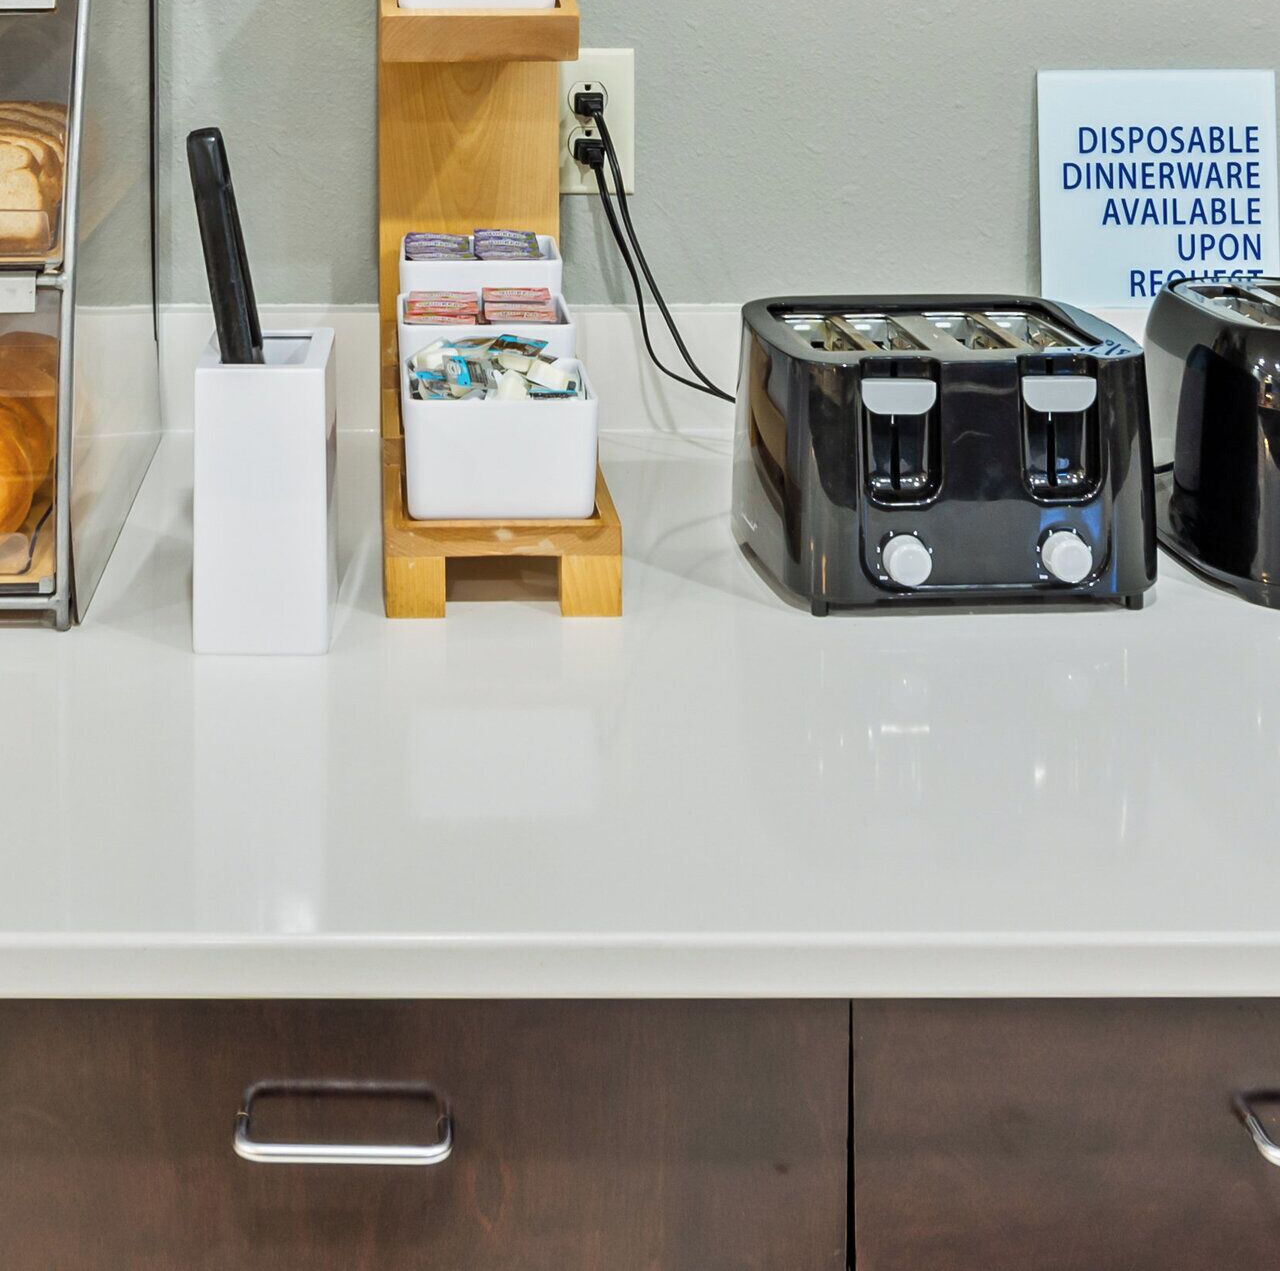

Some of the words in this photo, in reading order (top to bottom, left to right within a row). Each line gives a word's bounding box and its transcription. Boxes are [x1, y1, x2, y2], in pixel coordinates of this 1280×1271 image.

[1078, 126, 1260, 154] DISPOSABLE
[1062, 162, 1261, 190] DINNERWARE
[1101, 197, 1262, 226] AVAILABLE
[1177, 234, 1262, 262] UPON
